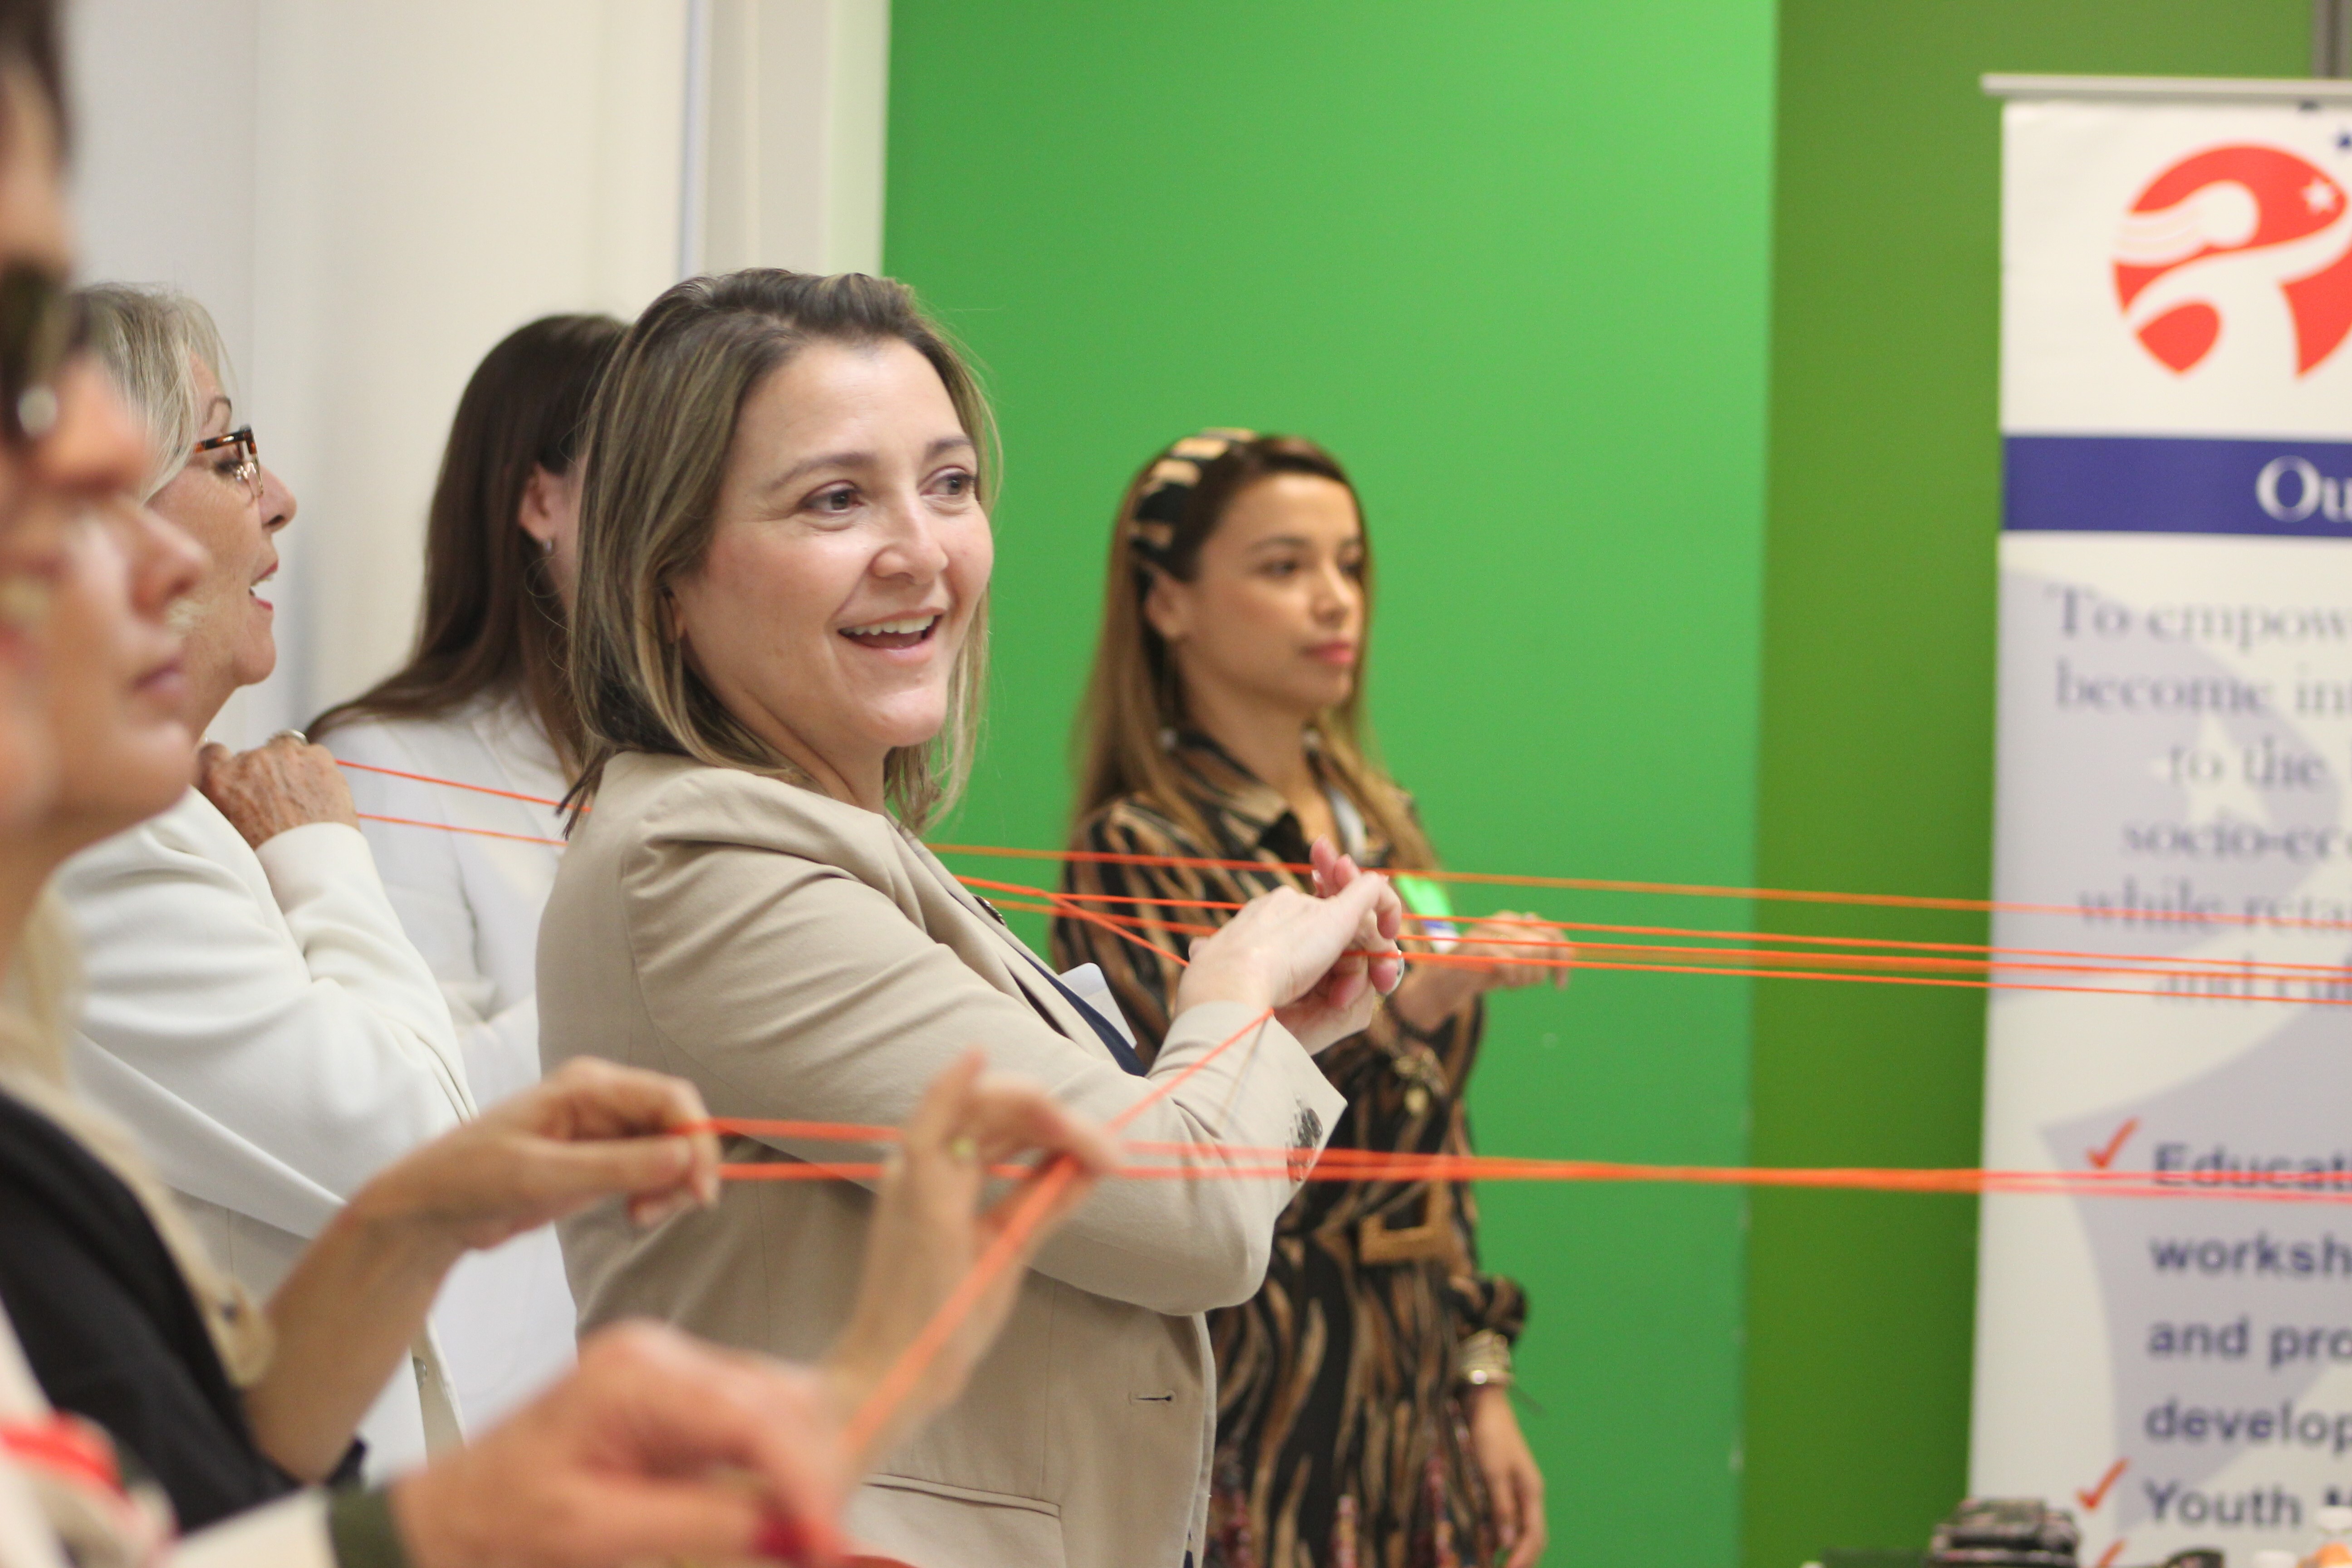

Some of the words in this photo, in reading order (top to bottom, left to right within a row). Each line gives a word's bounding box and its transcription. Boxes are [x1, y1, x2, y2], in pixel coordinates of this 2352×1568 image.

[2045, 582, 2133, 642] To
[2055, 657, 2273, 716] become
[2294, 662, 2352, 718] in
[2169, 745, 2226, 788] to
[2242, 736, 2328, 793] the
[2078, 876, 2222, 935] while
[2242, 895, 2352, 936] reta
[2154, 1141, 2352, 1191] Educat
[2148, 1230, 2352, 1279] worksh
[2147, 1312, 2251, 1357] and
[2269, 1324, 2352, 1372] pro
[2141, 1477, 2304, 1530] Youth
